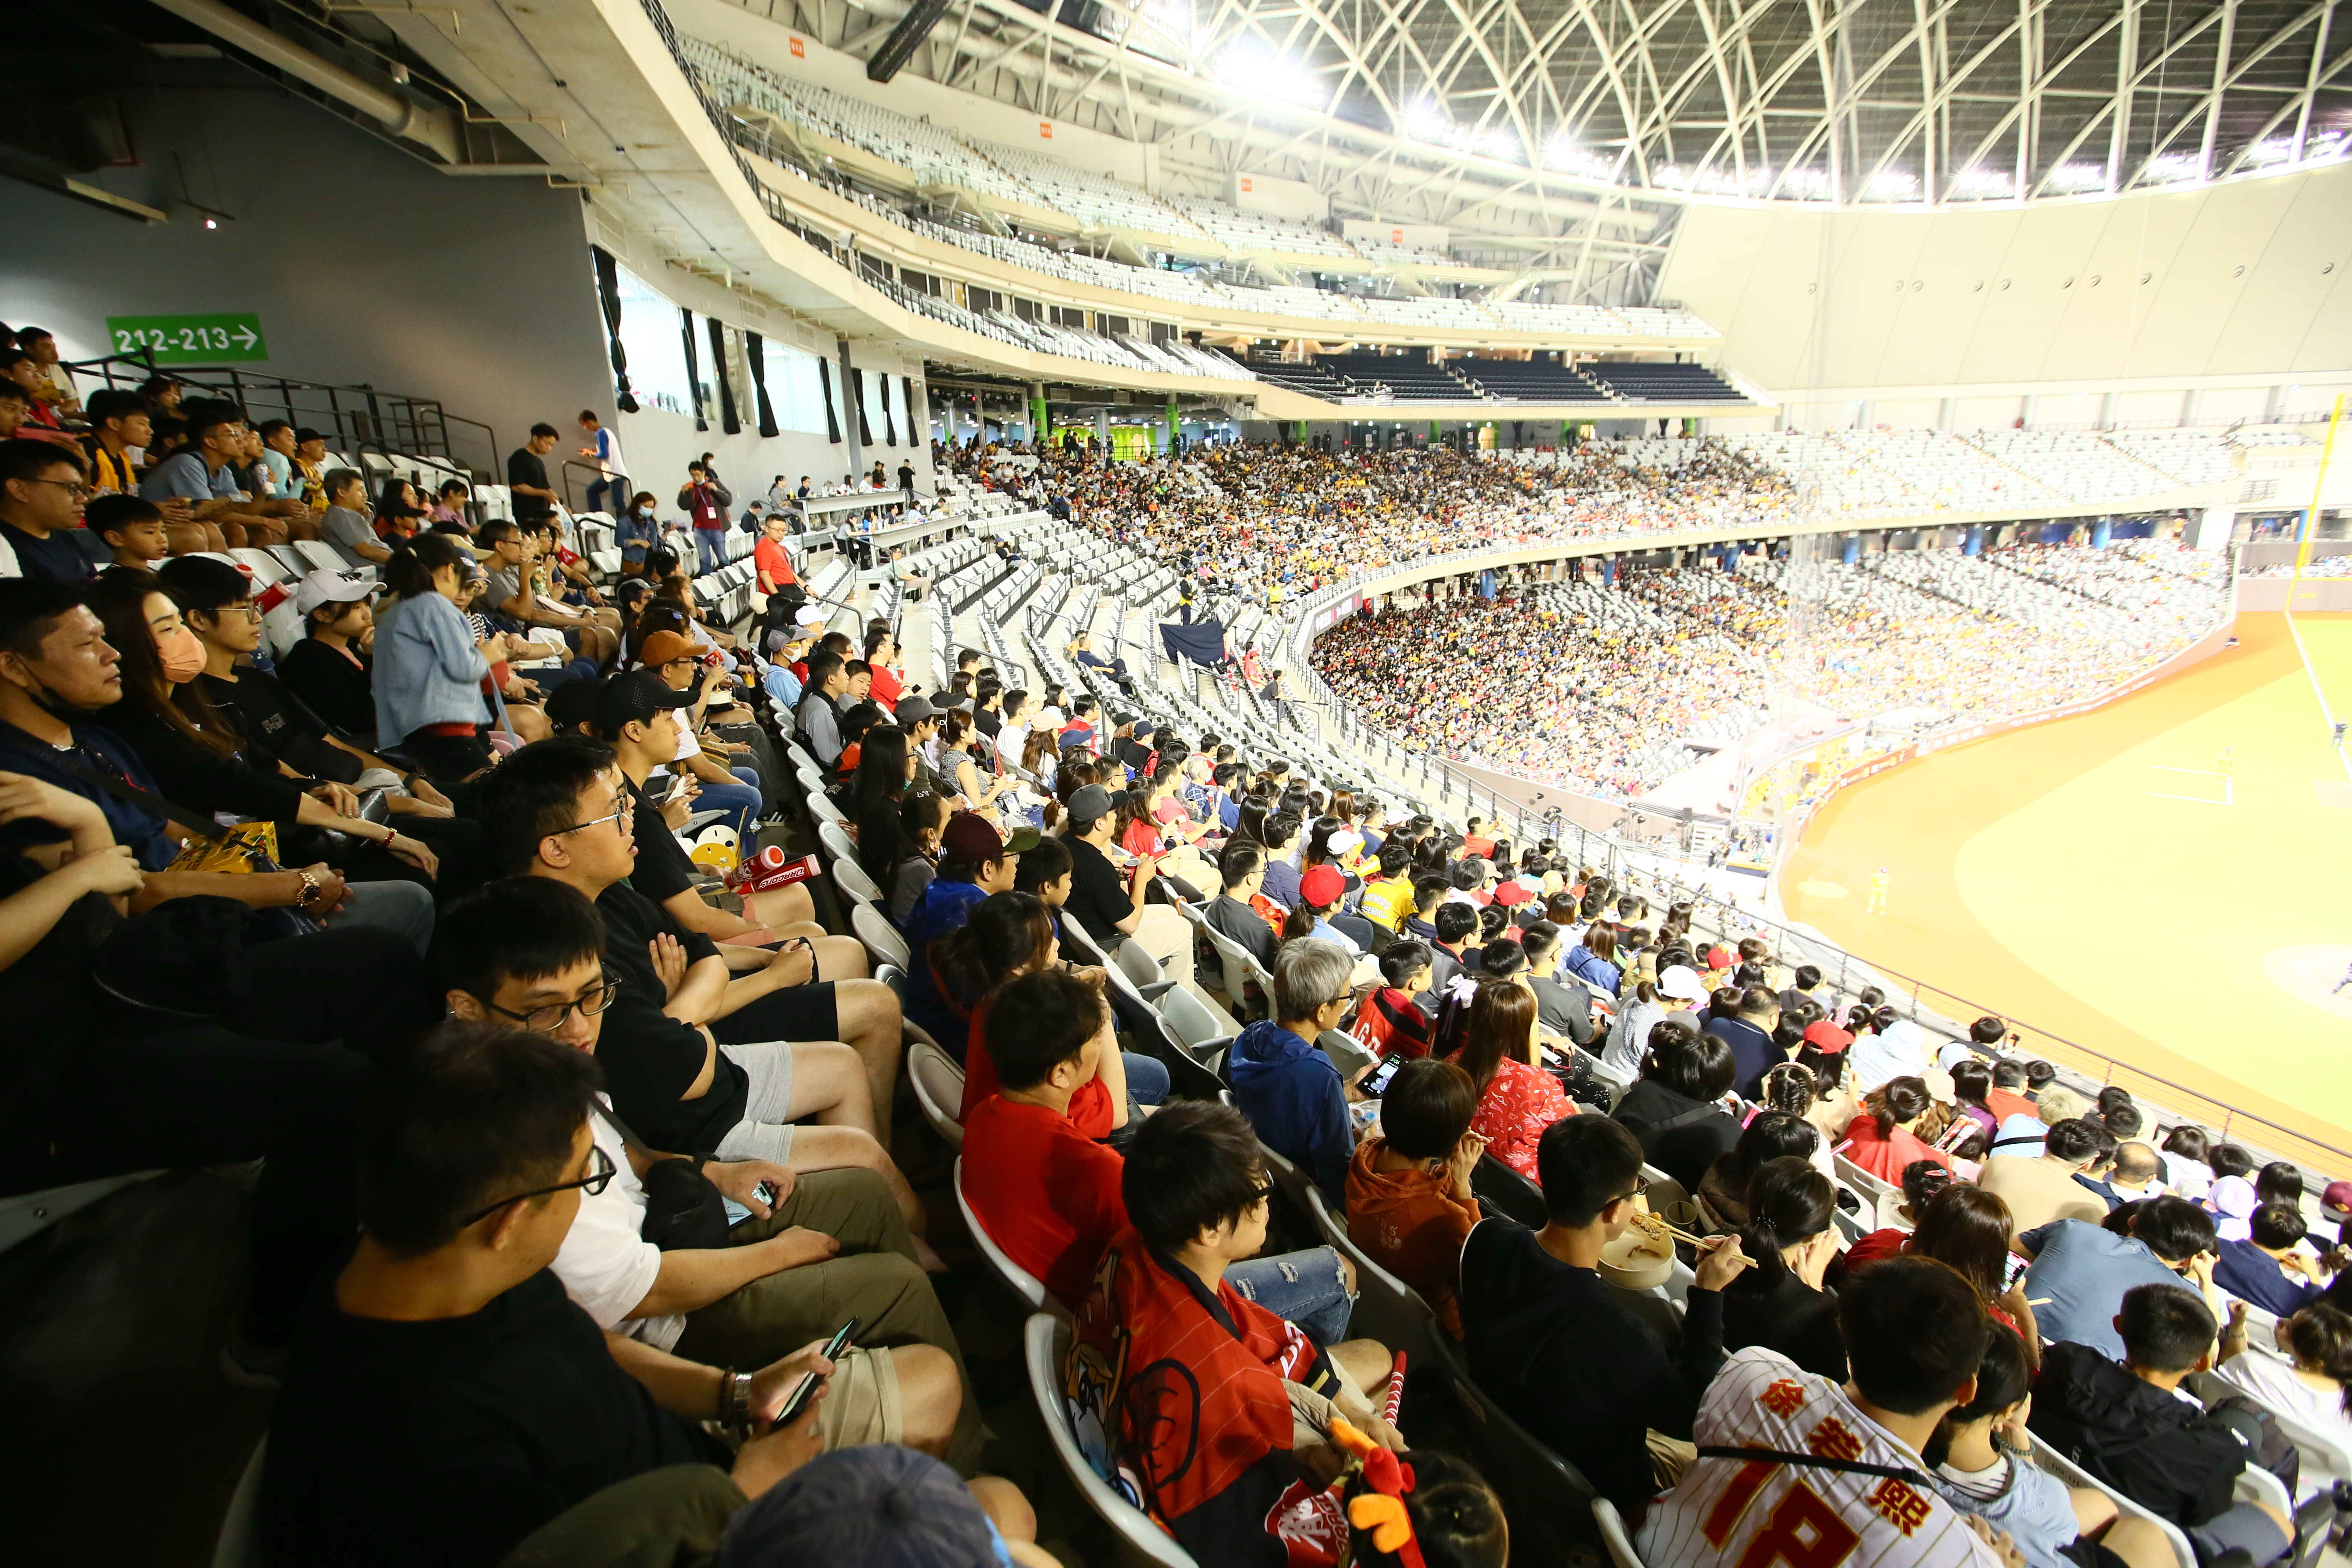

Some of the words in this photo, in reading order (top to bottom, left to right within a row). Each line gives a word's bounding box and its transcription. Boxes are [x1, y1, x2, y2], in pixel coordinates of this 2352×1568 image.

[115, 327, 230, 353] 212-213
[757, 866, 805, 889] DRAGONS
[1390, 1057, 1400, 1065] 5:06
